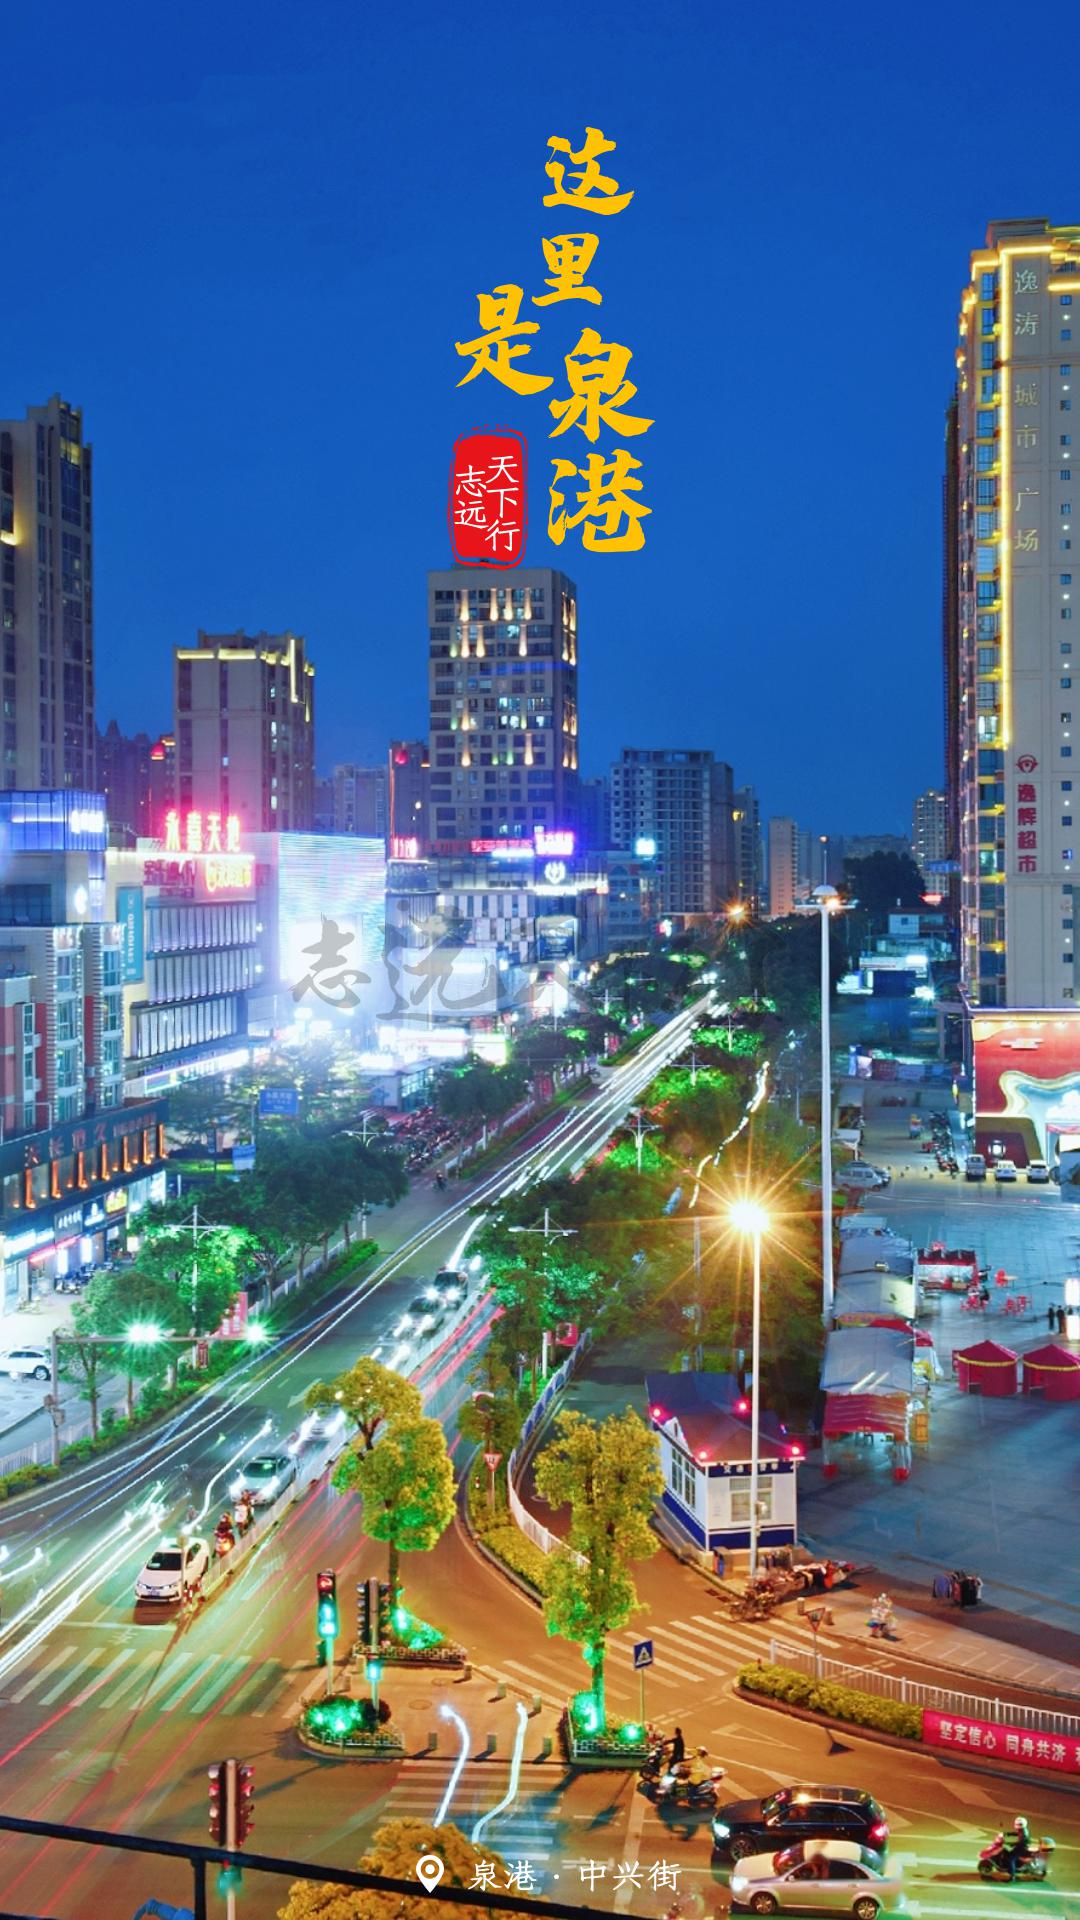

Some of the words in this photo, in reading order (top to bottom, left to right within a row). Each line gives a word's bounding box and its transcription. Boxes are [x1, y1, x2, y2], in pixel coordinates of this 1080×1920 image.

[940, 1719, 997, 1750] 坚定信心
[1006, 1733, 1066, 1763] 同舟共济
